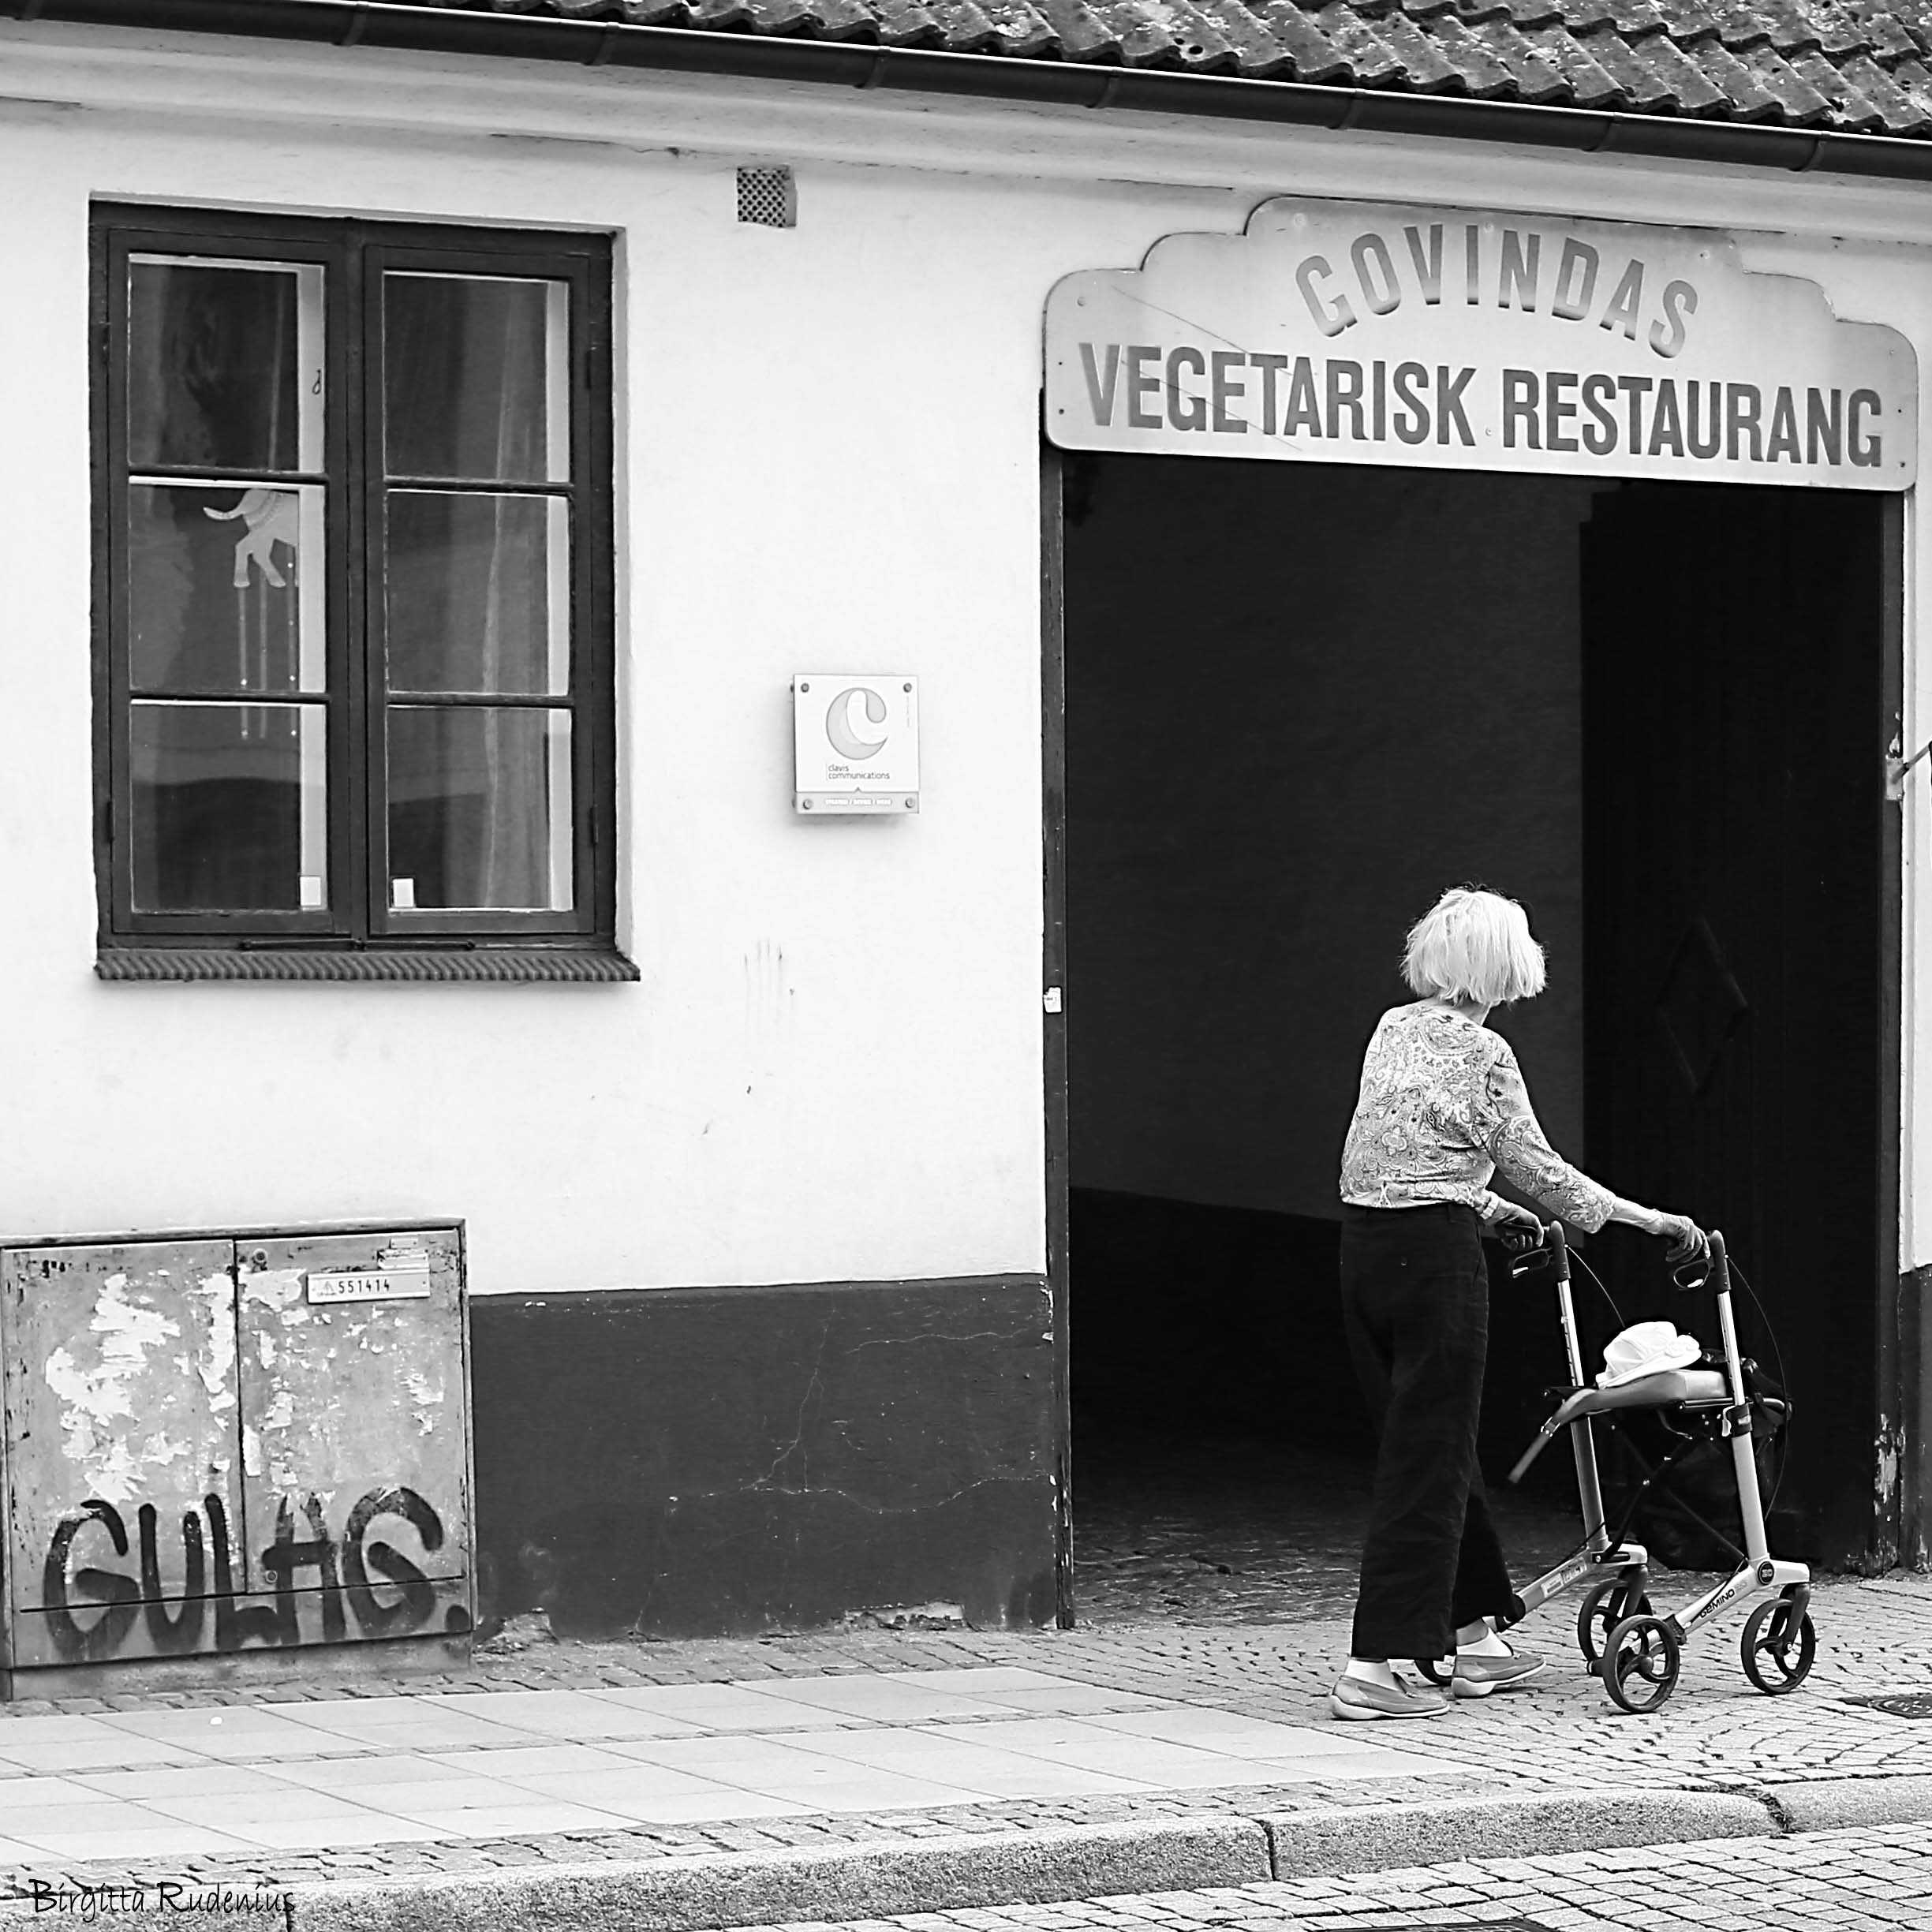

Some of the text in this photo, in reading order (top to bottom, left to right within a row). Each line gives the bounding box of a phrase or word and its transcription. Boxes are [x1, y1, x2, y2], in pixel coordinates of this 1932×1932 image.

[1295, 223, 1698, 359] GOVINDAS
[1079, 342, 1882, 468] VEGETARISK RESTAURANG
[828, 771, 890, 779] communications
[338, 1279, 390, 1294] 551414
[1699, 1588, 1736, 1618] GEMINO
